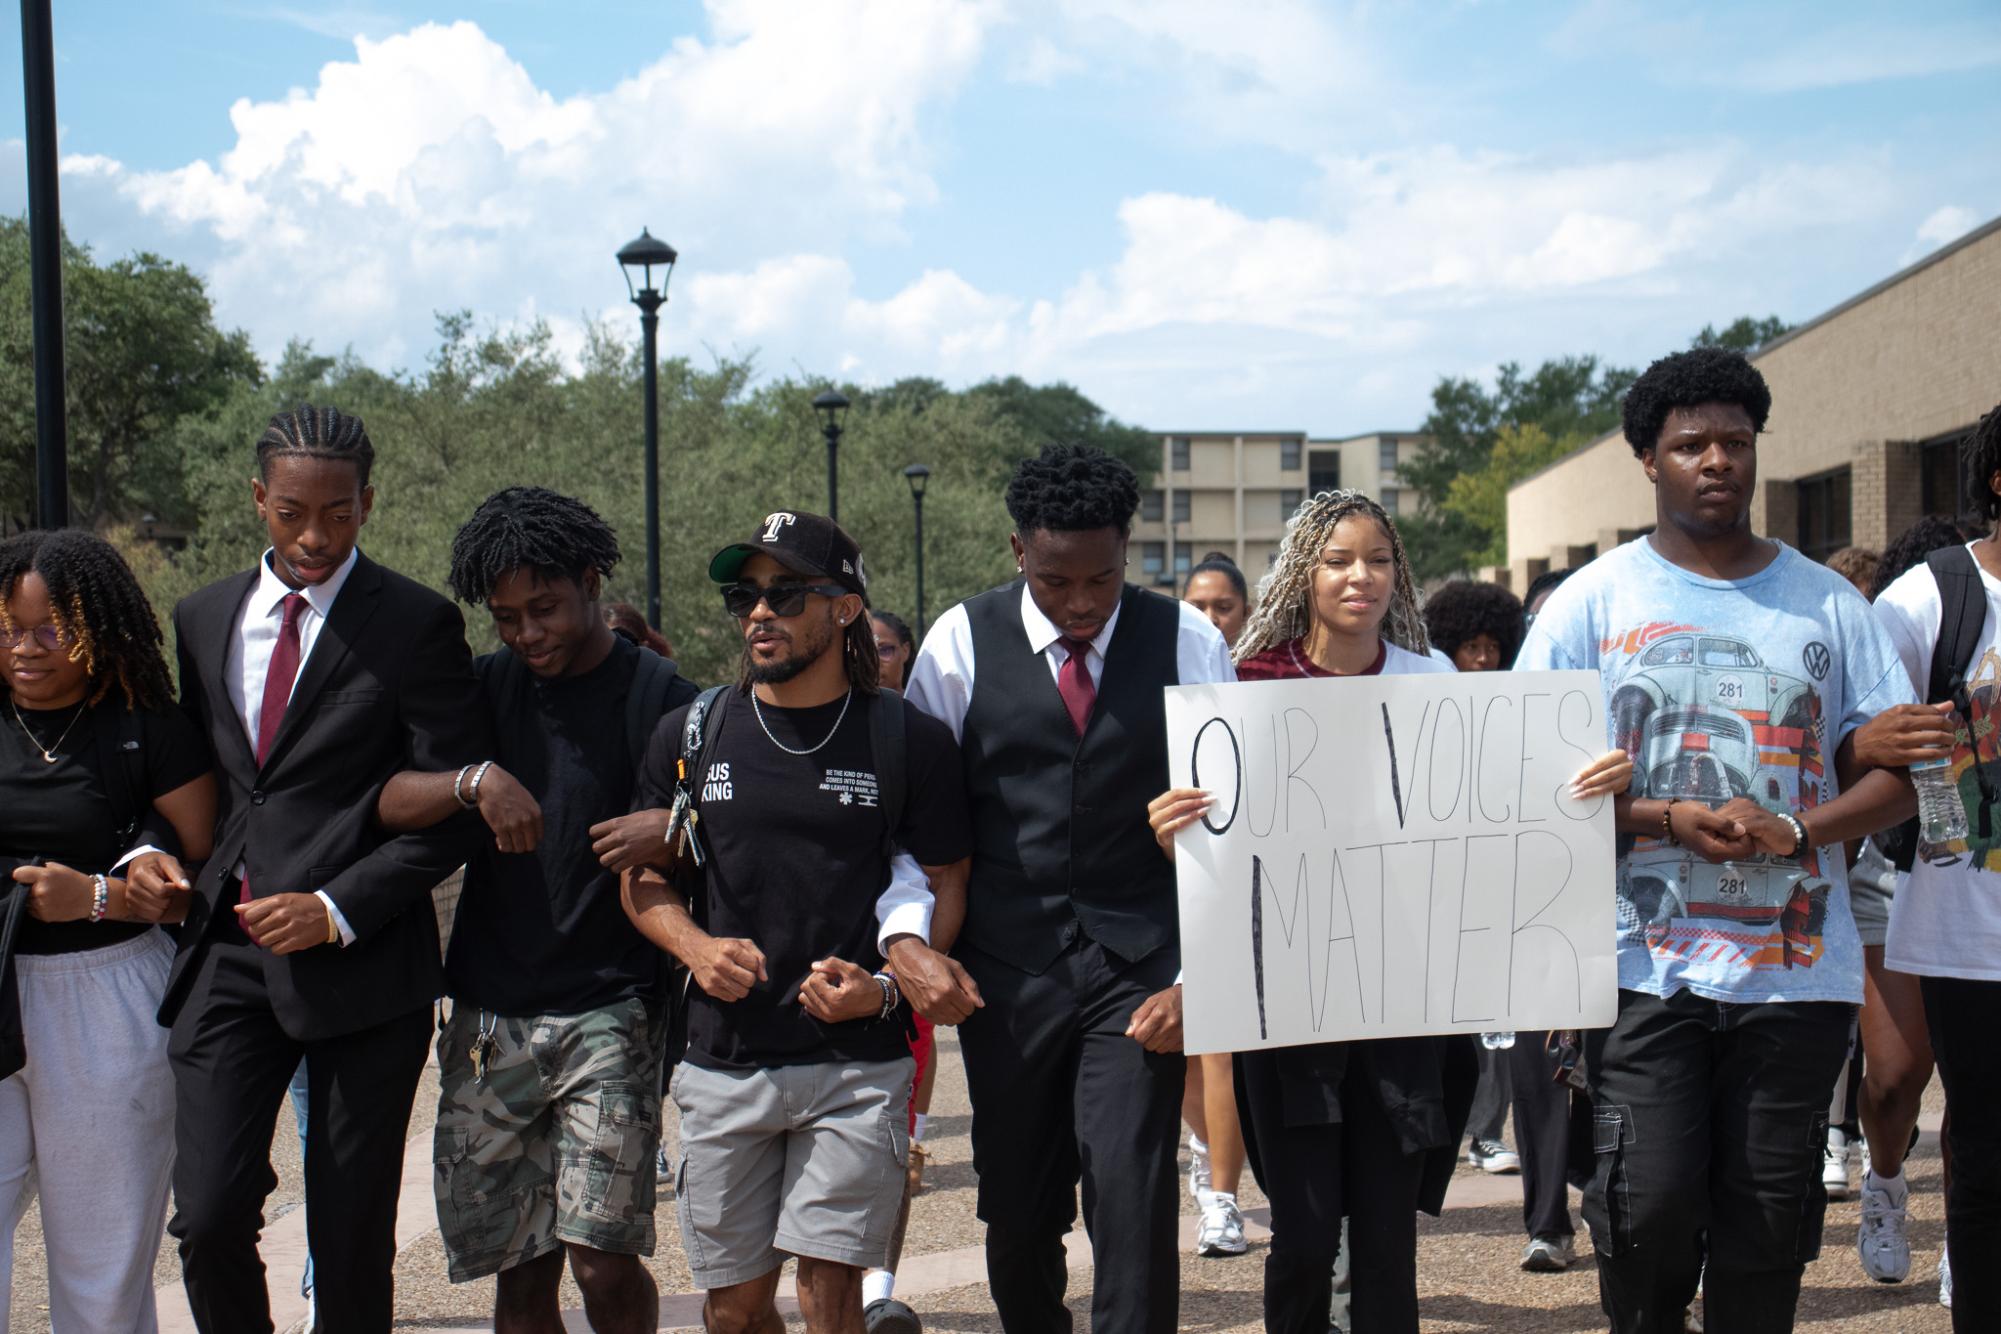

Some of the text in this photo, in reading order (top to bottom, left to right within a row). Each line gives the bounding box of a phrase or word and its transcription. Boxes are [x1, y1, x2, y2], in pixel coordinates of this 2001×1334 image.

[762, 512, 796, 542] T
[1718, 682, 1743, 699] 281
[1191, 689, 1606, 838] OUR VOICES
[1719, 878, 1745, 895] 281
[1251, 829, 1582, 1041] MATTER
